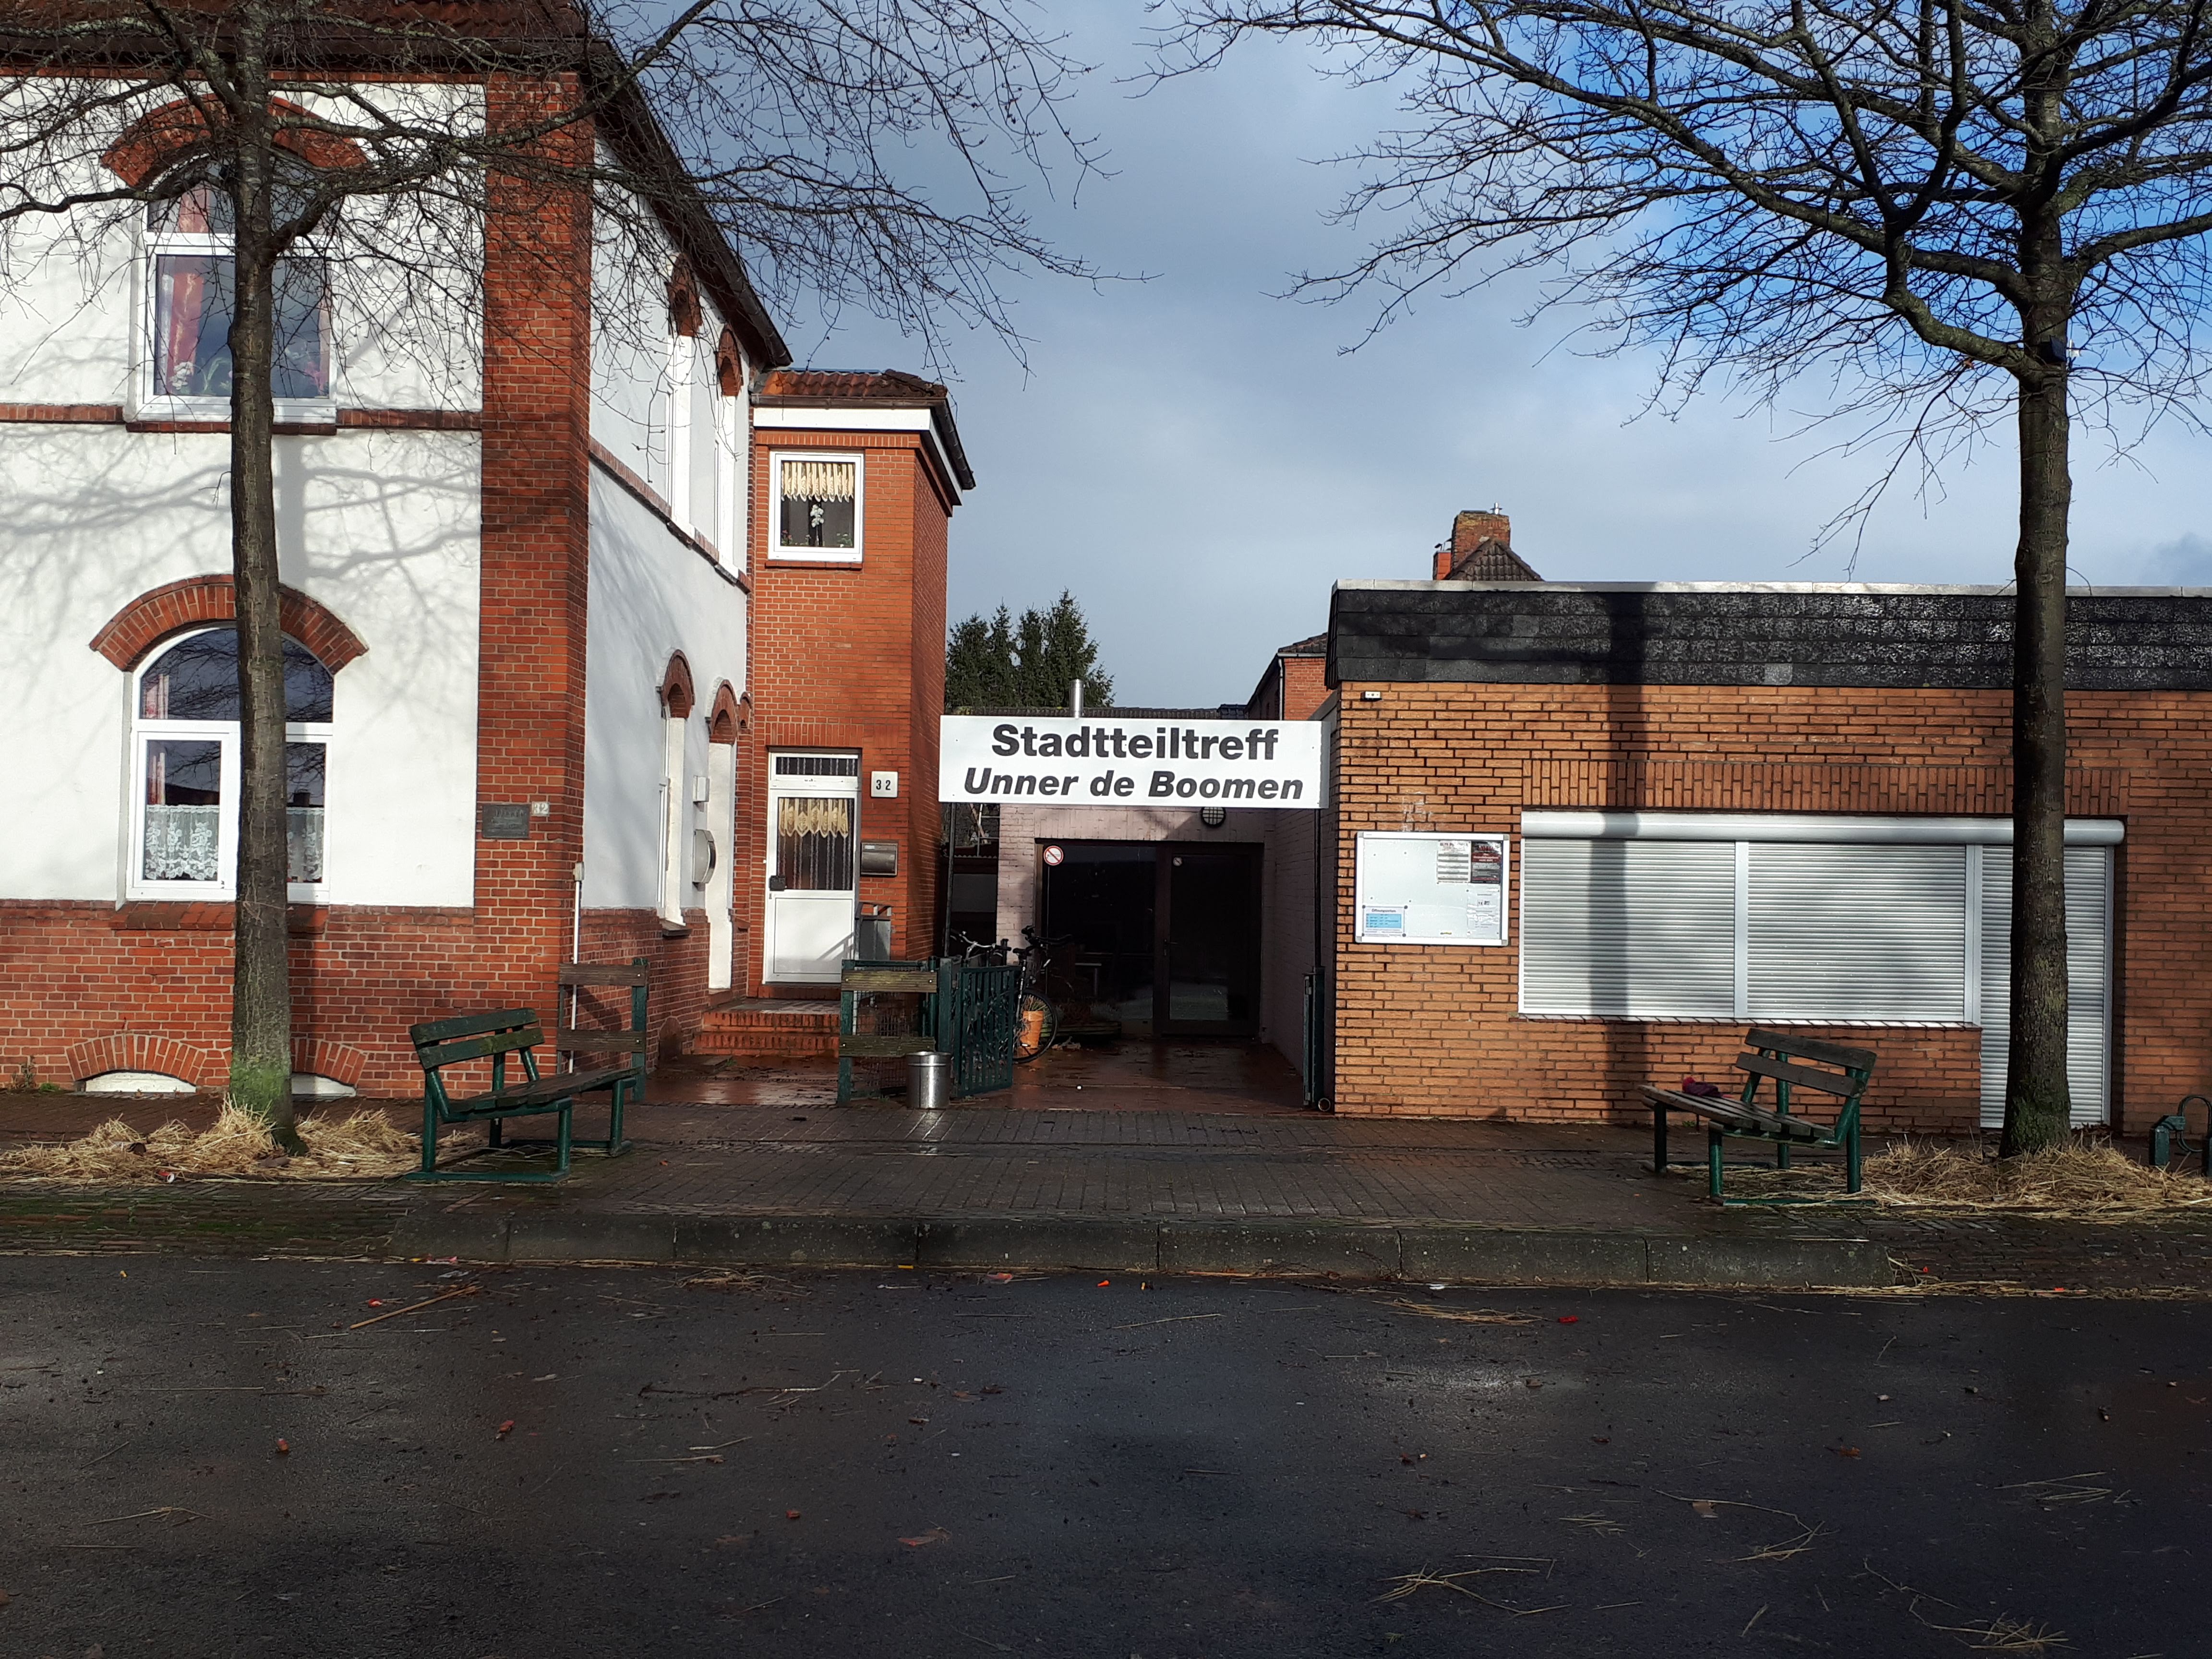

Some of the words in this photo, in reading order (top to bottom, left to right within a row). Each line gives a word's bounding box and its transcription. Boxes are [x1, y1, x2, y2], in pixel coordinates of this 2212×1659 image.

[992, 724, 1279, 760] Stadtteiltreff
[876, 779, 891, 791] 32
[964, 768, 1079, 795] Unner
[1090, 770, 1134, 797] de
[1148, 770, 1303, 799] Boomen
[533, 803, 548, 814] 32
